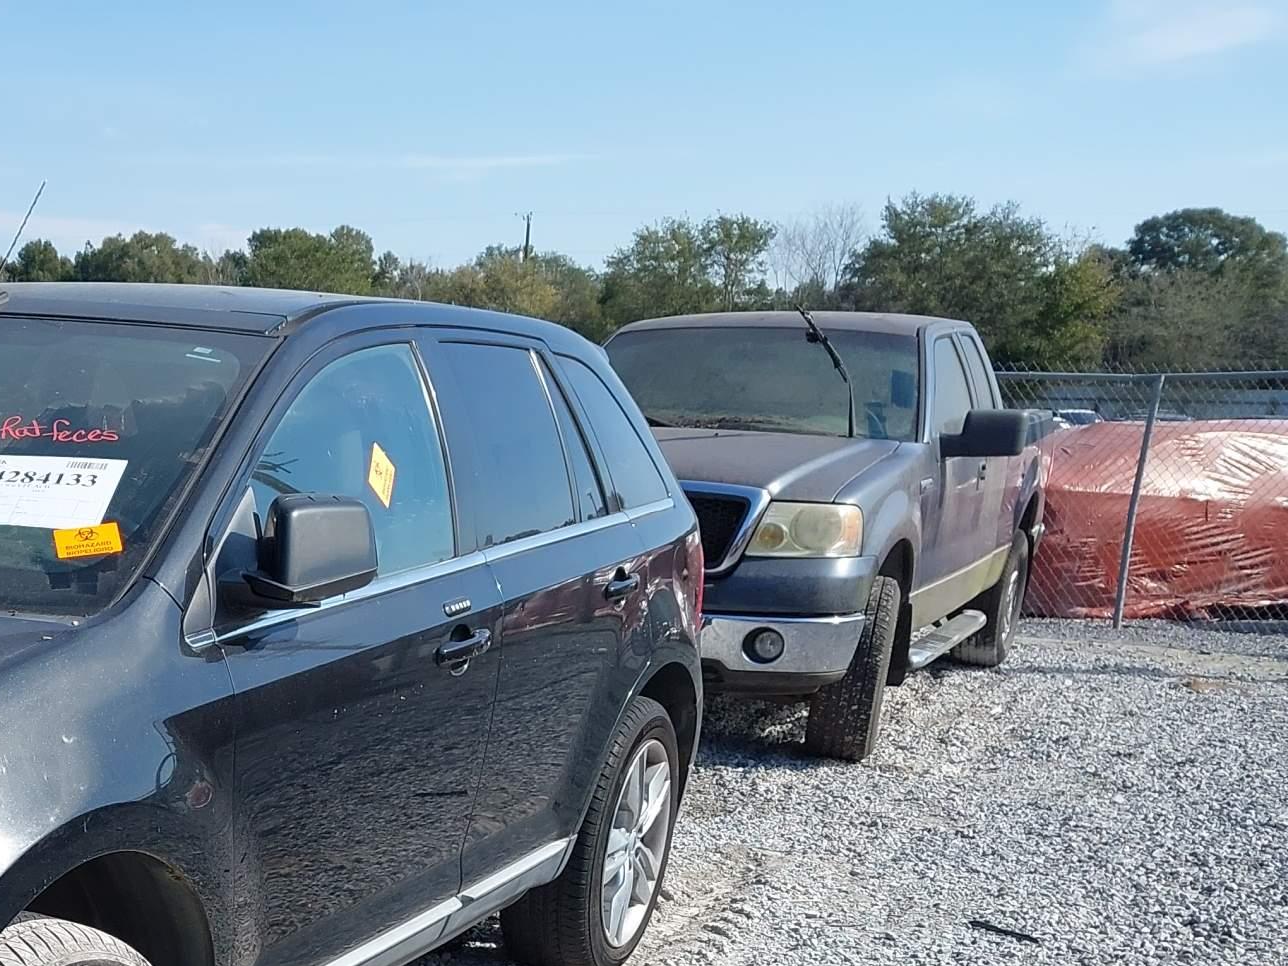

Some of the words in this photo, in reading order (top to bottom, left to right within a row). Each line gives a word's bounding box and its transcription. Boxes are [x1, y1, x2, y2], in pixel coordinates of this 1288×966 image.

[0, 415, 47, 440] Rat
[45, 418, 120, 442] feces
[65, 540, 112, 551] BIOHAZARD
